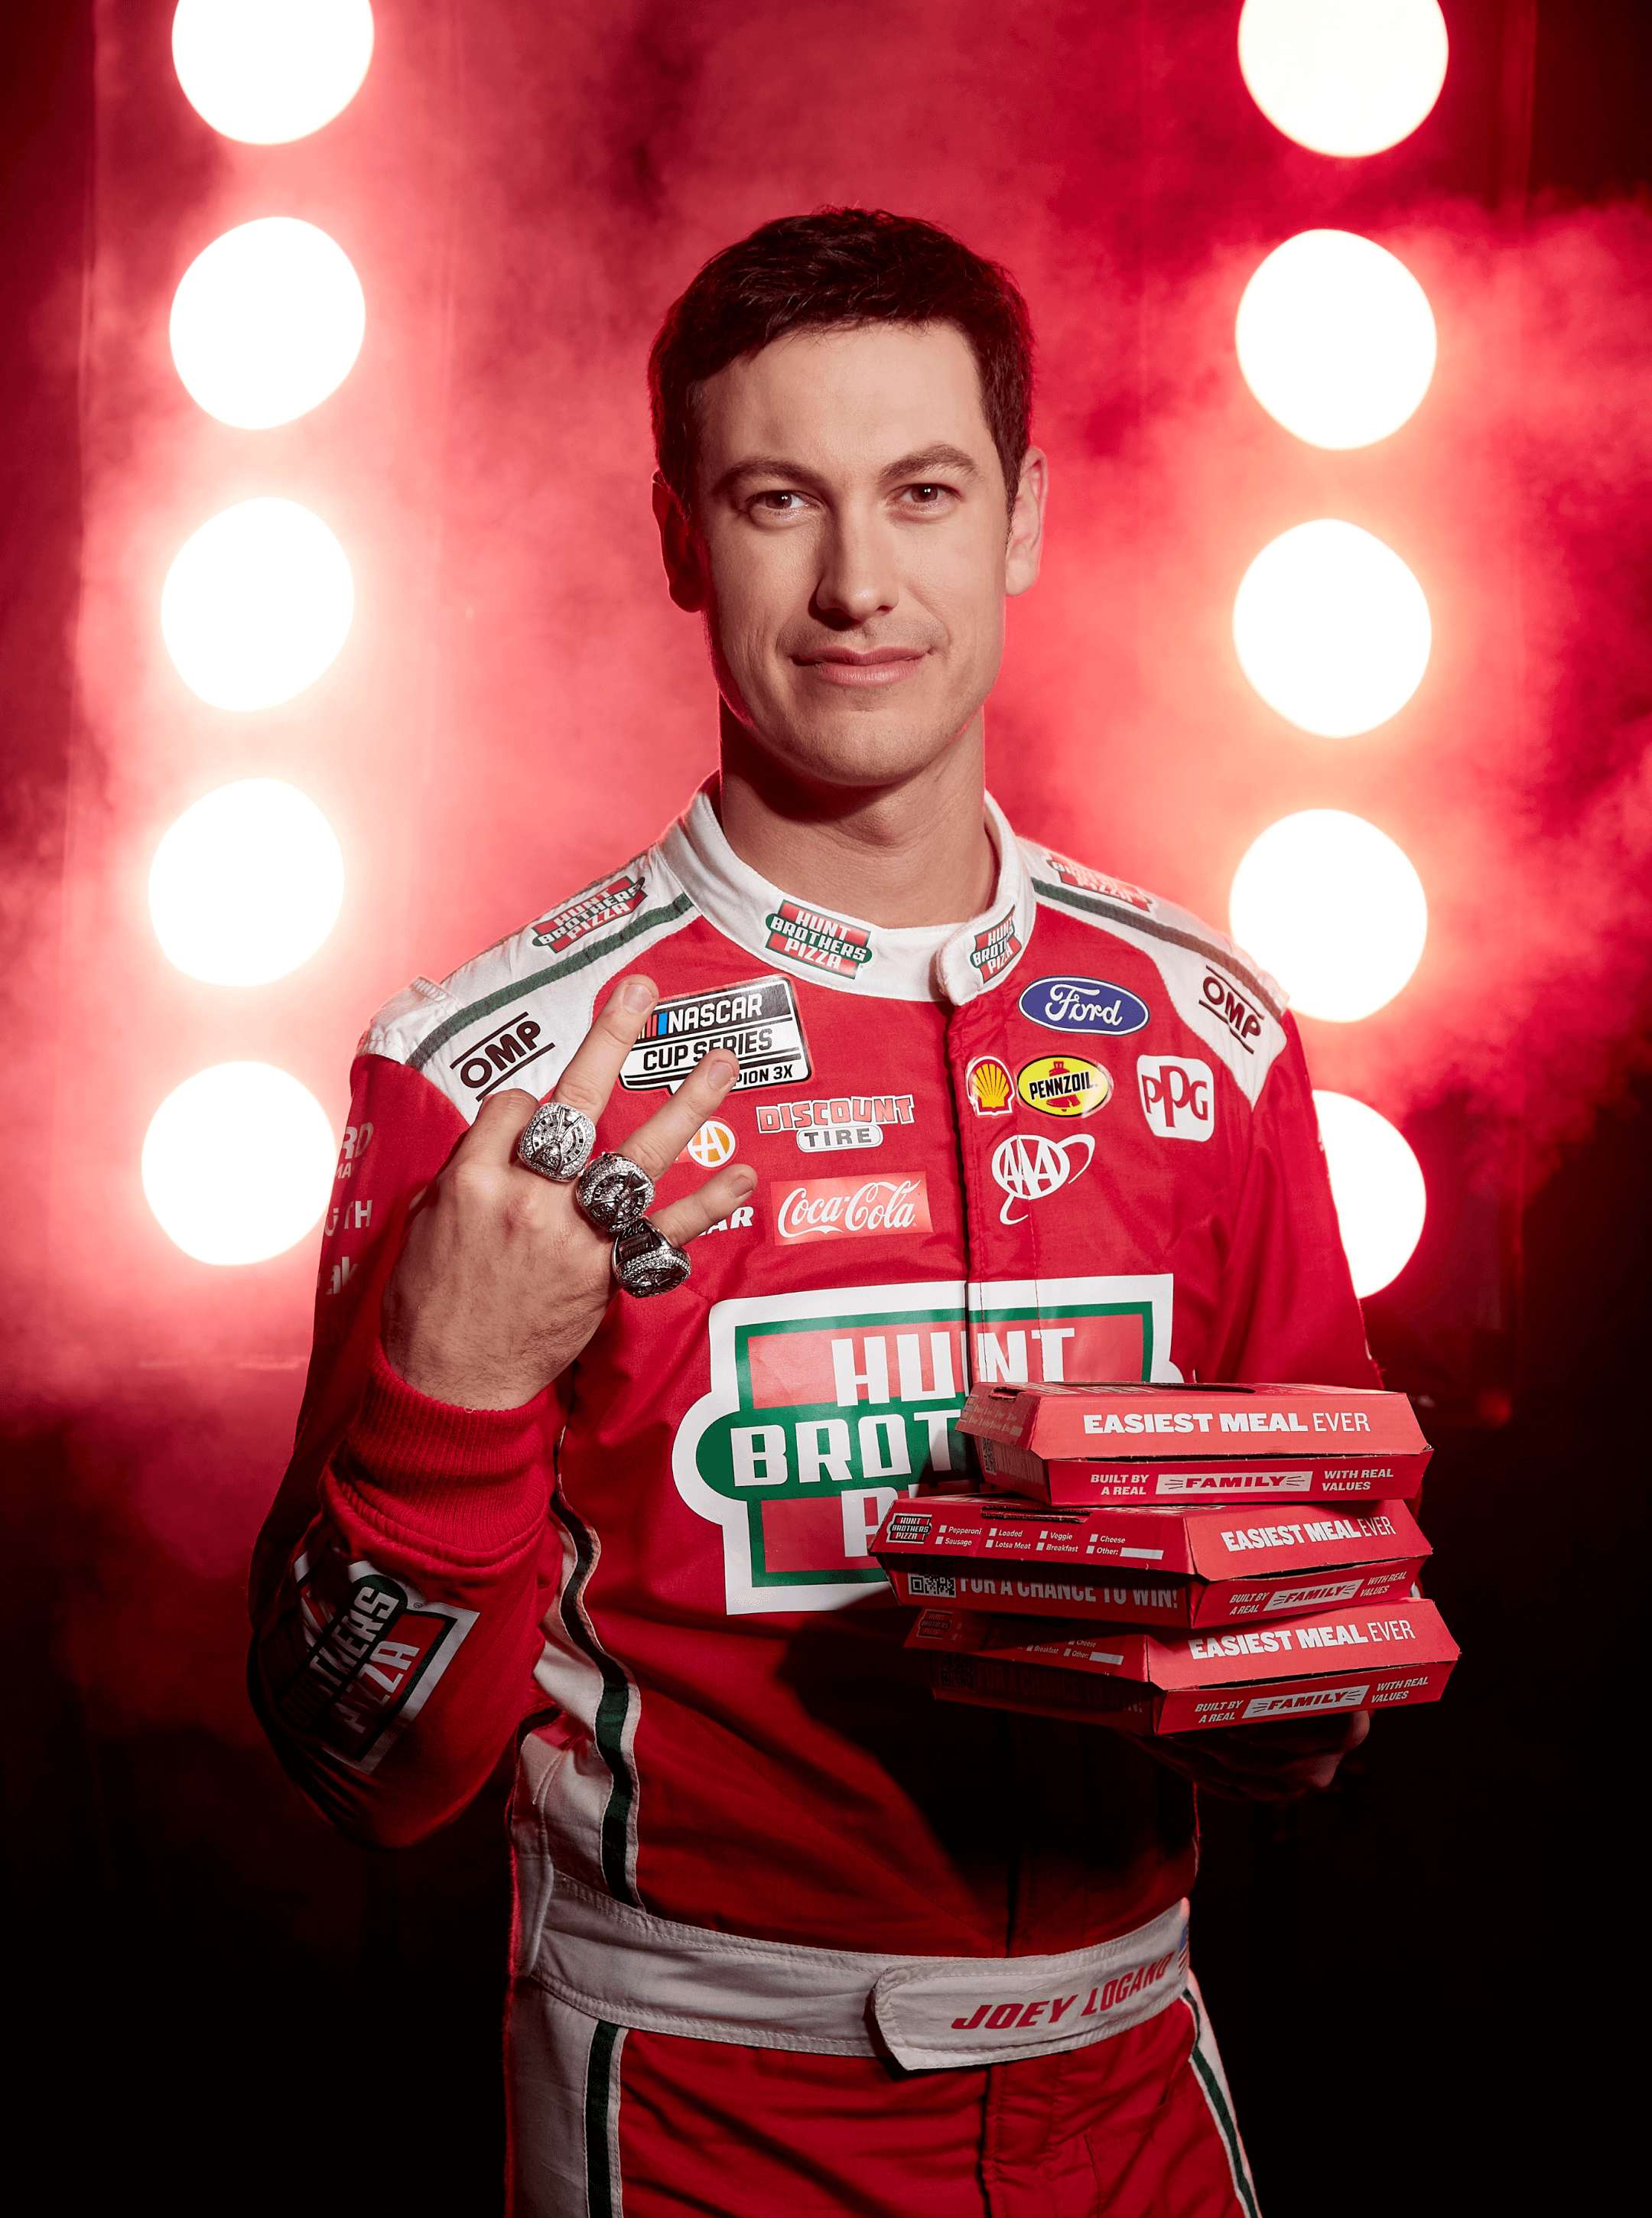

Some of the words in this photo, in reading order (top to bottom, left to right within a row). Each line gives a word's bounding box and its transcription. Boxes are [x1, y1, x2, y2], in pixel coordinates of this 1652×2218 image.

[538, 884, 642, 945] BROTHERS
[554, 888, 610, 926] HUNT
[567, 902, 630, 940] PIZZA
[795, 910, 851, 941] HUNT
[770, 915, 867, 961] BROTHERS
[784, 937, 842, 969] PIZZA
[668, 994, 763, 1033] NASCAR
[1045, 984, 1123, 1026] Ford
[1202, 977, 1261, 1038] OMP
[460, 1021, 541, 1088] OMP
[643, 1045, 688, 1071] CUP
[773, 1064, 793, 1080] 3X
[1029, 1072, 1094, 1099] PENNZOIL
[1141, 1065, 1208, 1128] PPG
[758, 1096, 912, 1132] DISCOUNT
[804, 1128, 872, 1148] TIRE
[993, 1134, 1069, 1200] AAA
[778, 1180, 921, 1237] Coca-Cola
[831, 1328, 1075, 1407] HUNT
[1083, 1413, 1213, 1434] EASIEST
[1220, 1413, 1309, 1433] MEAL
[1313, 1413, 1371, 1432] EVER
[730, 1409, 961, 1487] BROT
[1091, 1475, 1130, 1484] BUILT
[1130, 1474, 1150, 1484] BY
[1185, 1475, 1286, 1488] FAMILY
[1324, 1470, 1356, 1479] WITH
[1358, 1468, 1394, 1478] REAL
[1101, 1486, 1111, 1495] A
[1113, 1486, 1147, 1495] REAL
[1322, 1481, 1371, 1491] VALUES
[892, 1524, 929, 1533] BROTHERS
[948, 1526, 982, 1535] Pepperoni
[999, 1529, 1023, 1537] Loaded
[1050, 1532, 1073, 1540] Veggie
[1221, 1524, 1305, 1552] EASIEST
[1303, 1519, 1362, 1543] MEAL
[1358, 1516, 1396, 1537] EVER
[945, 1537, 972, 1547] Sausage
[995, 1540, 1013, 1549] Lotsa
[1046, 1543, 1078, 1553] Breakfast
[1097, 1546, 1119, 1555] Other:
[1367, 1574, 1388, 1585] WITH
[1387, 1571, 1407, 1582] REAL
[1230, 1594, 1257, 1604] BUILT
[1257, 1592, 1270, 1601] BY
[1284, 1585, 1345, 1603] FAMILY
[1359, 1585, 1389, 1597] VALUES
[1230, 1607, 1237, 1615] A
[1237, 1605, 1260, 1615] REAL
[1076, 1639, 1097, 1648] Cheese
[1188, 1630, 1293, 1660] EASIEST
[1296, 1624, 1368, 1649] MEAL
[1367, 1620, 1416, 1642] EVER
[1034, 1645, 1059, 1654] Breakfast
[1072, 1650, 1089, 1659] Other:
[1377, 1680, 1403, 1692] WITH
[1404, 1677, 1429, 1687] REAL
[1267, 1691, 1349, 1711] FAMILY
[1371, 1690, 1410, 1703] VALUES
[1195, 1702, 1227, 1712] BUILT
[1228, 1700, 1244, 1709] BY
[1198, 1715, 1207, 1723] A
[1208, 1713, 1236, 1722] REAL
[951, 1994, 1079, 2029] JOEY
[1081, 1952, 1176, 2017] LOGANO
